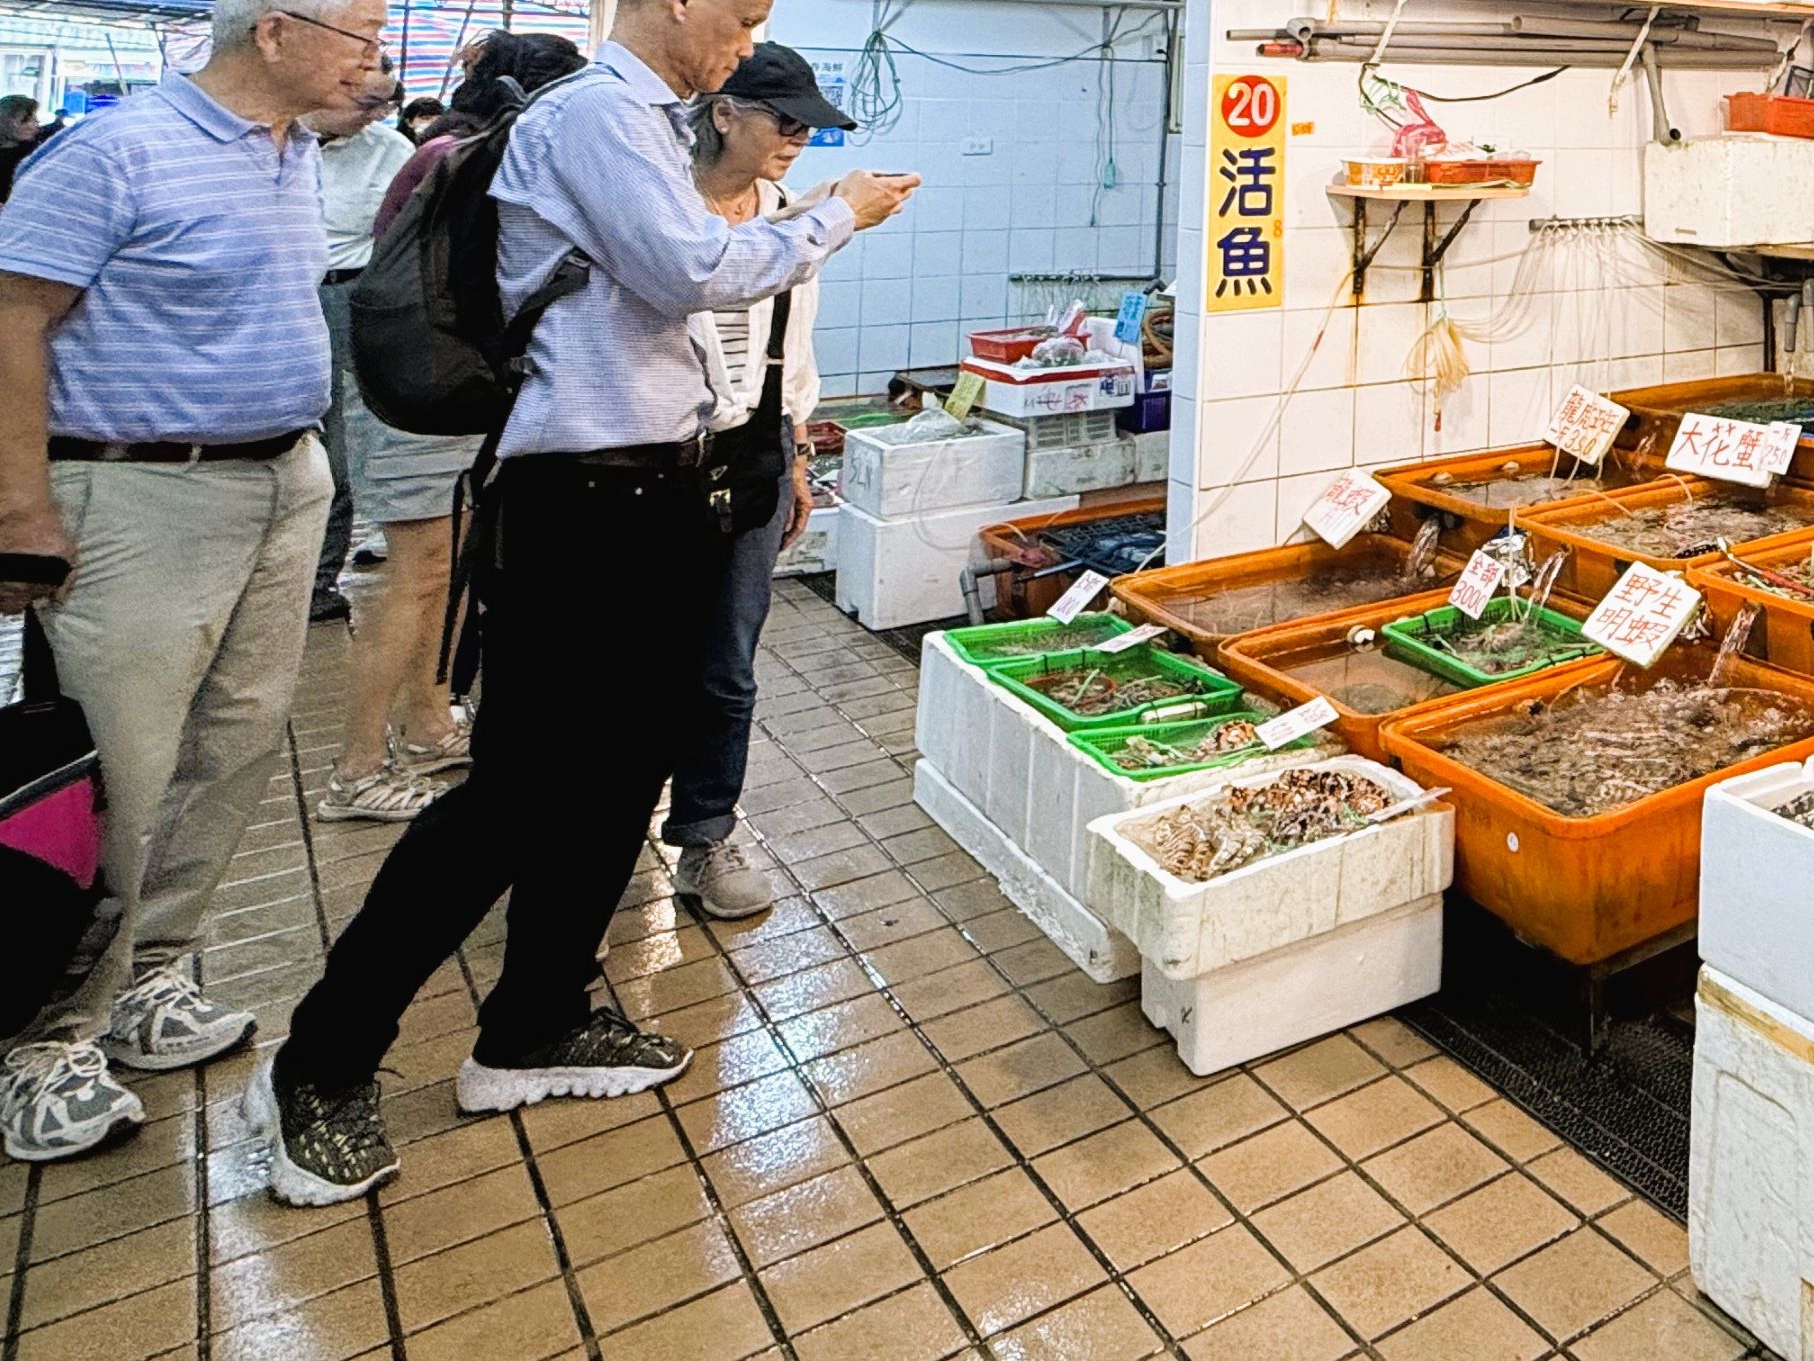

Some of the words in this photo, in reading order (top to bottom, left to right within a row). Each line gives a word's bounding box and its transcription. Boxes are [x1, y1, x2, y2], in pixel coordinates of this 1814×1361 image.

[1228, 82, 1275, 127] 20
[1216, 146, 1277, 298] 活魚
[1672, 421, 1764, 471] 大花蟹
[1468, 553, 1500, 588] 全部
[1613, 572, 1683, 620] 野生
[1595, 606, 1670, 651] 明蝦
